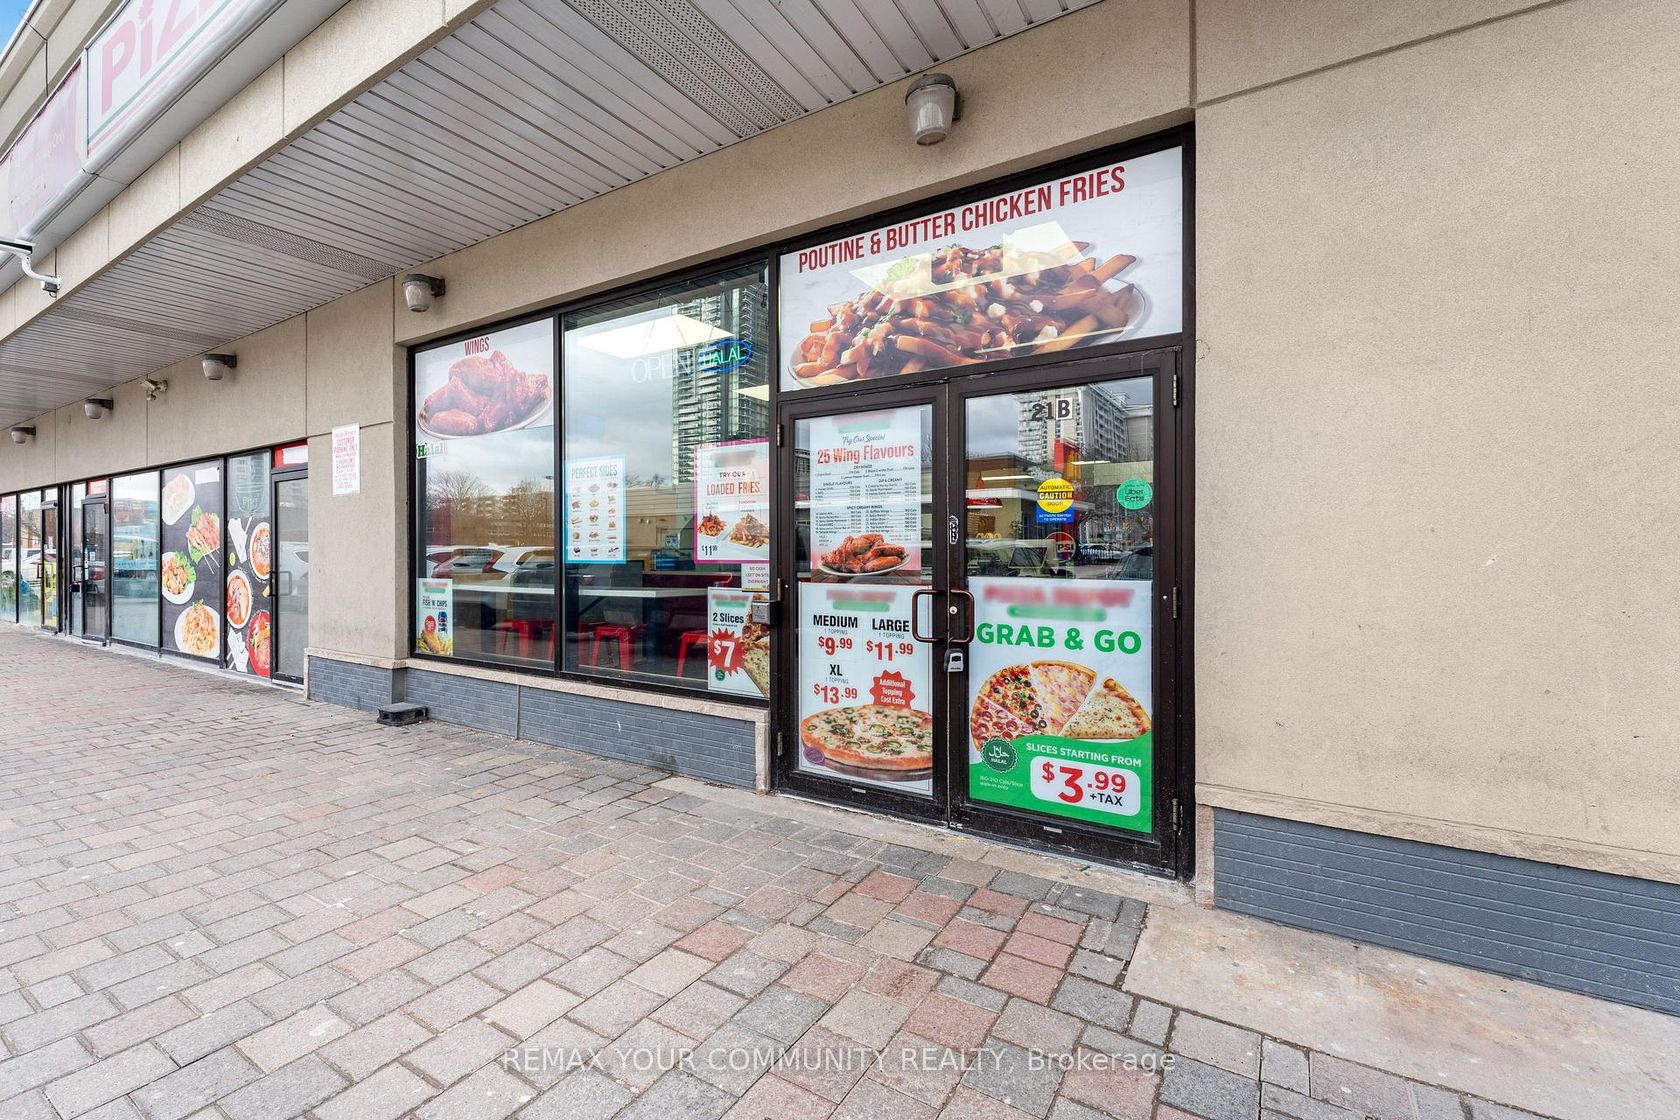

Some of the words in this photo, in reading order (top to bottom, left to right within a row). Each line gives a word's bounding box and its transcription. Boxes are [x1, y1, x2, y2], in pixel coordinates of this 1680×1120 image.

[799, 239, 864, 273] POUTINE
[869, 232, 881, 254] &
[886, 213, 956, 251] BUTTER
[961, 186, 1052, 232] CHICKEN
[1059, 165, 1125, 208] FRIES
[464, 337, 490, 356] WINGS
[702, 345, 745, 366] HALAL
[631, 351, 692, 383] OPEN
[817, 449, 830, 464] 25
[833, 447, 860, 464] Wing
[863, 444, 914, 460] Flavours
[571, 466, 598, 480] PERFECT
[599, 464, 618, 477] SIDES
[707, 482, 735, 495] LOADED
[738, 481, 760, 494] FRIES
[1039, 491, 1073, 499] CAUTION
[712, 612, 718, 622] 2
[719, 612, 744, 624] Slices
[813, 614, 858, 628] MEDIUM
[872, 618, 910, 633] LARGE
[818, 636, 852, 656] $9.99
[977, 622, 1056, 648] GRAB
[1064, 628, 1084, 651] &
[1094, 630, 1142, 654] GO
[713, 640, 735, 667] $7
[866, 640, 913, 661] $11.99
[830, 664, 843, 676] XL
[879, 678, 905, 688] Additional
[882, 687, 903, 696] Topping
[814, 683, 858, 704] $13.99
[892, 697, 905, 705] Extra
[1026, 742, 1057, 755] SLICES
[1060, 748, 1109, 762] STARTING
[1111, 755, 1142, 767] FROM
[1041, 762, 1126, 803] $3.99
[1089, 792, 1123, 807] +TAX
